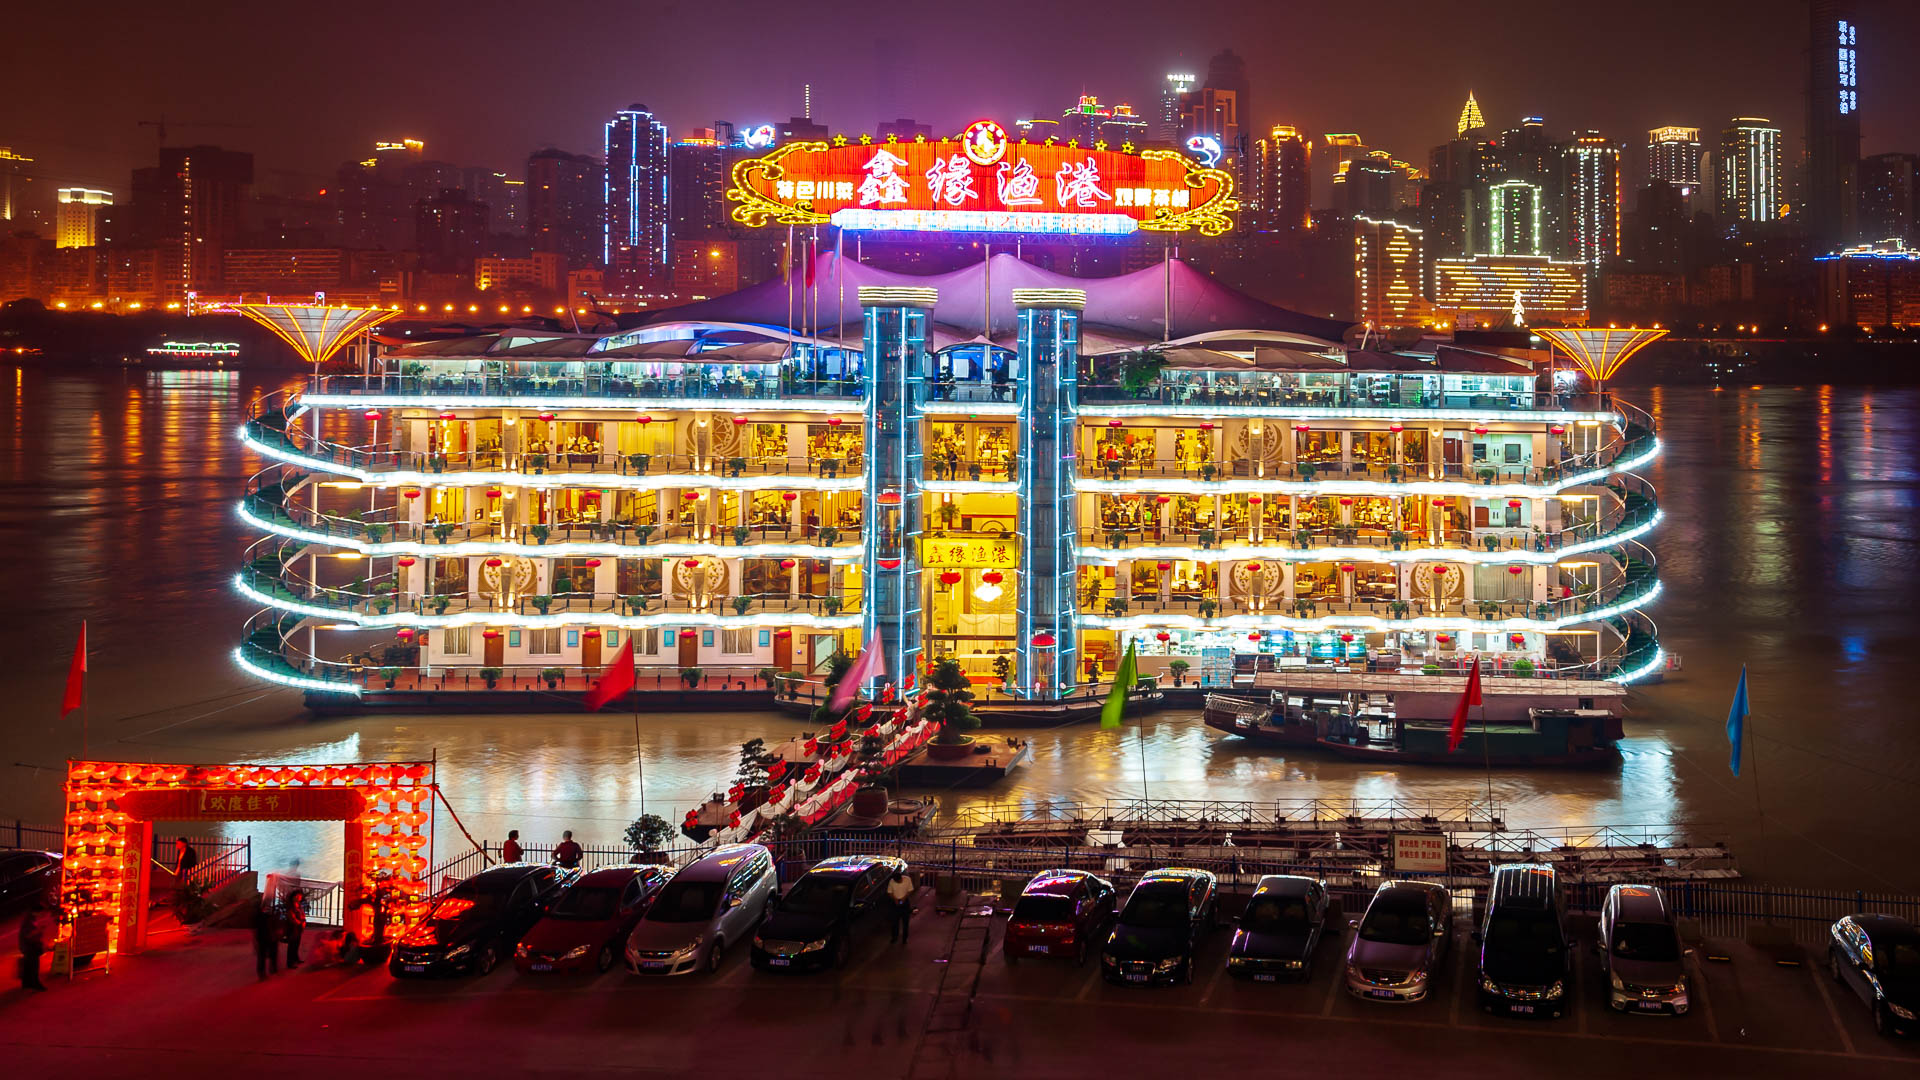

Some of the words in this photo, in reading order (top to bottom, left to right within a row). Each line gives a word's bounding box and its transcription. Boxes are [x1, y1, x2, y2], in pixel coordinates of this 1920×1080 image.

[857, 149, 1112, 207] 鑫缘渔港
[776, 180, 854, 201] 特色川菜
[928, 544, 1010, 564] 鑫缘渔港
[210, 795, 281, 812] 欢度佳节
